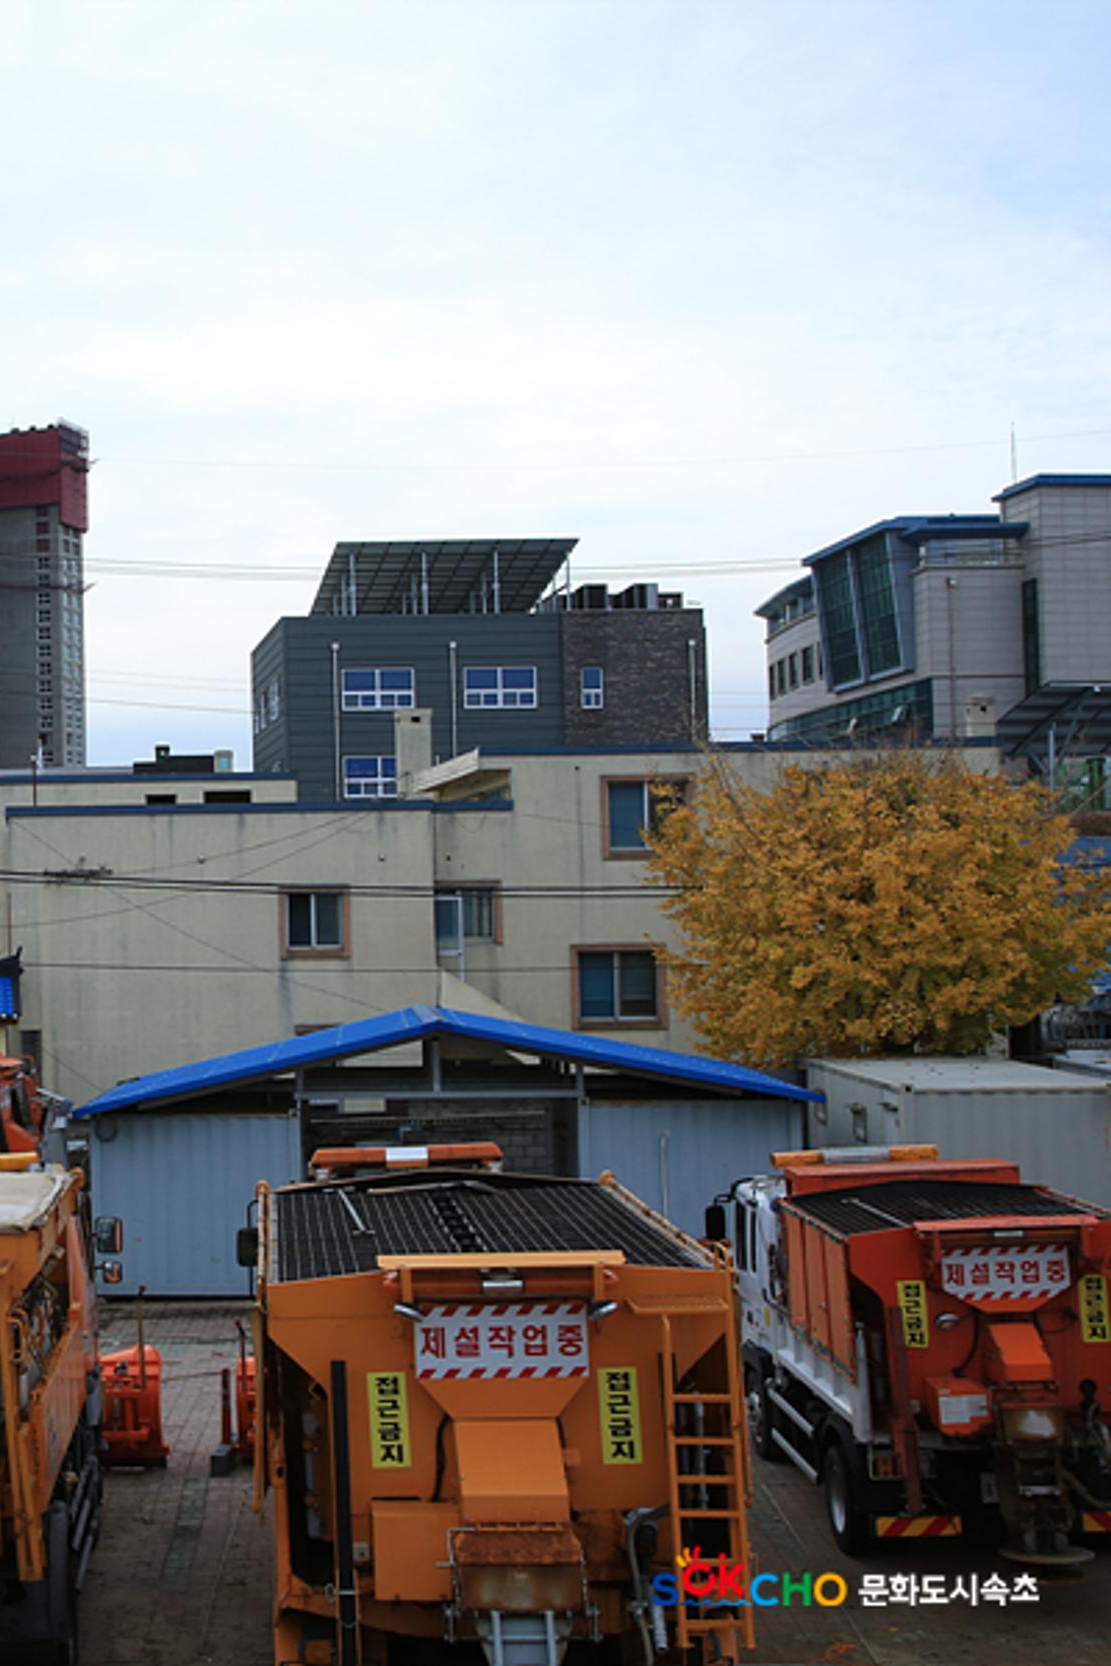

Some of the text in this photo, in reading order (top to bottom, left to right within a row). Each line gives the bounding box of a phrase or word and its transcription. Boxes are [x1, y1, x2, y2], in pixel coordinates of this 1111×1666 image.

[946, 1259, 1066, 1287] 제설작업중
[903, 1283, 926, 1346] 접근금지
[1085, 1276, 1107, 1340] 접근금지
[420, 1324, 585, 1359] 제설작업중
[375, 1376, 405, 1464] 접근금지
[605, 1371, 635, 1460] 접근금지
